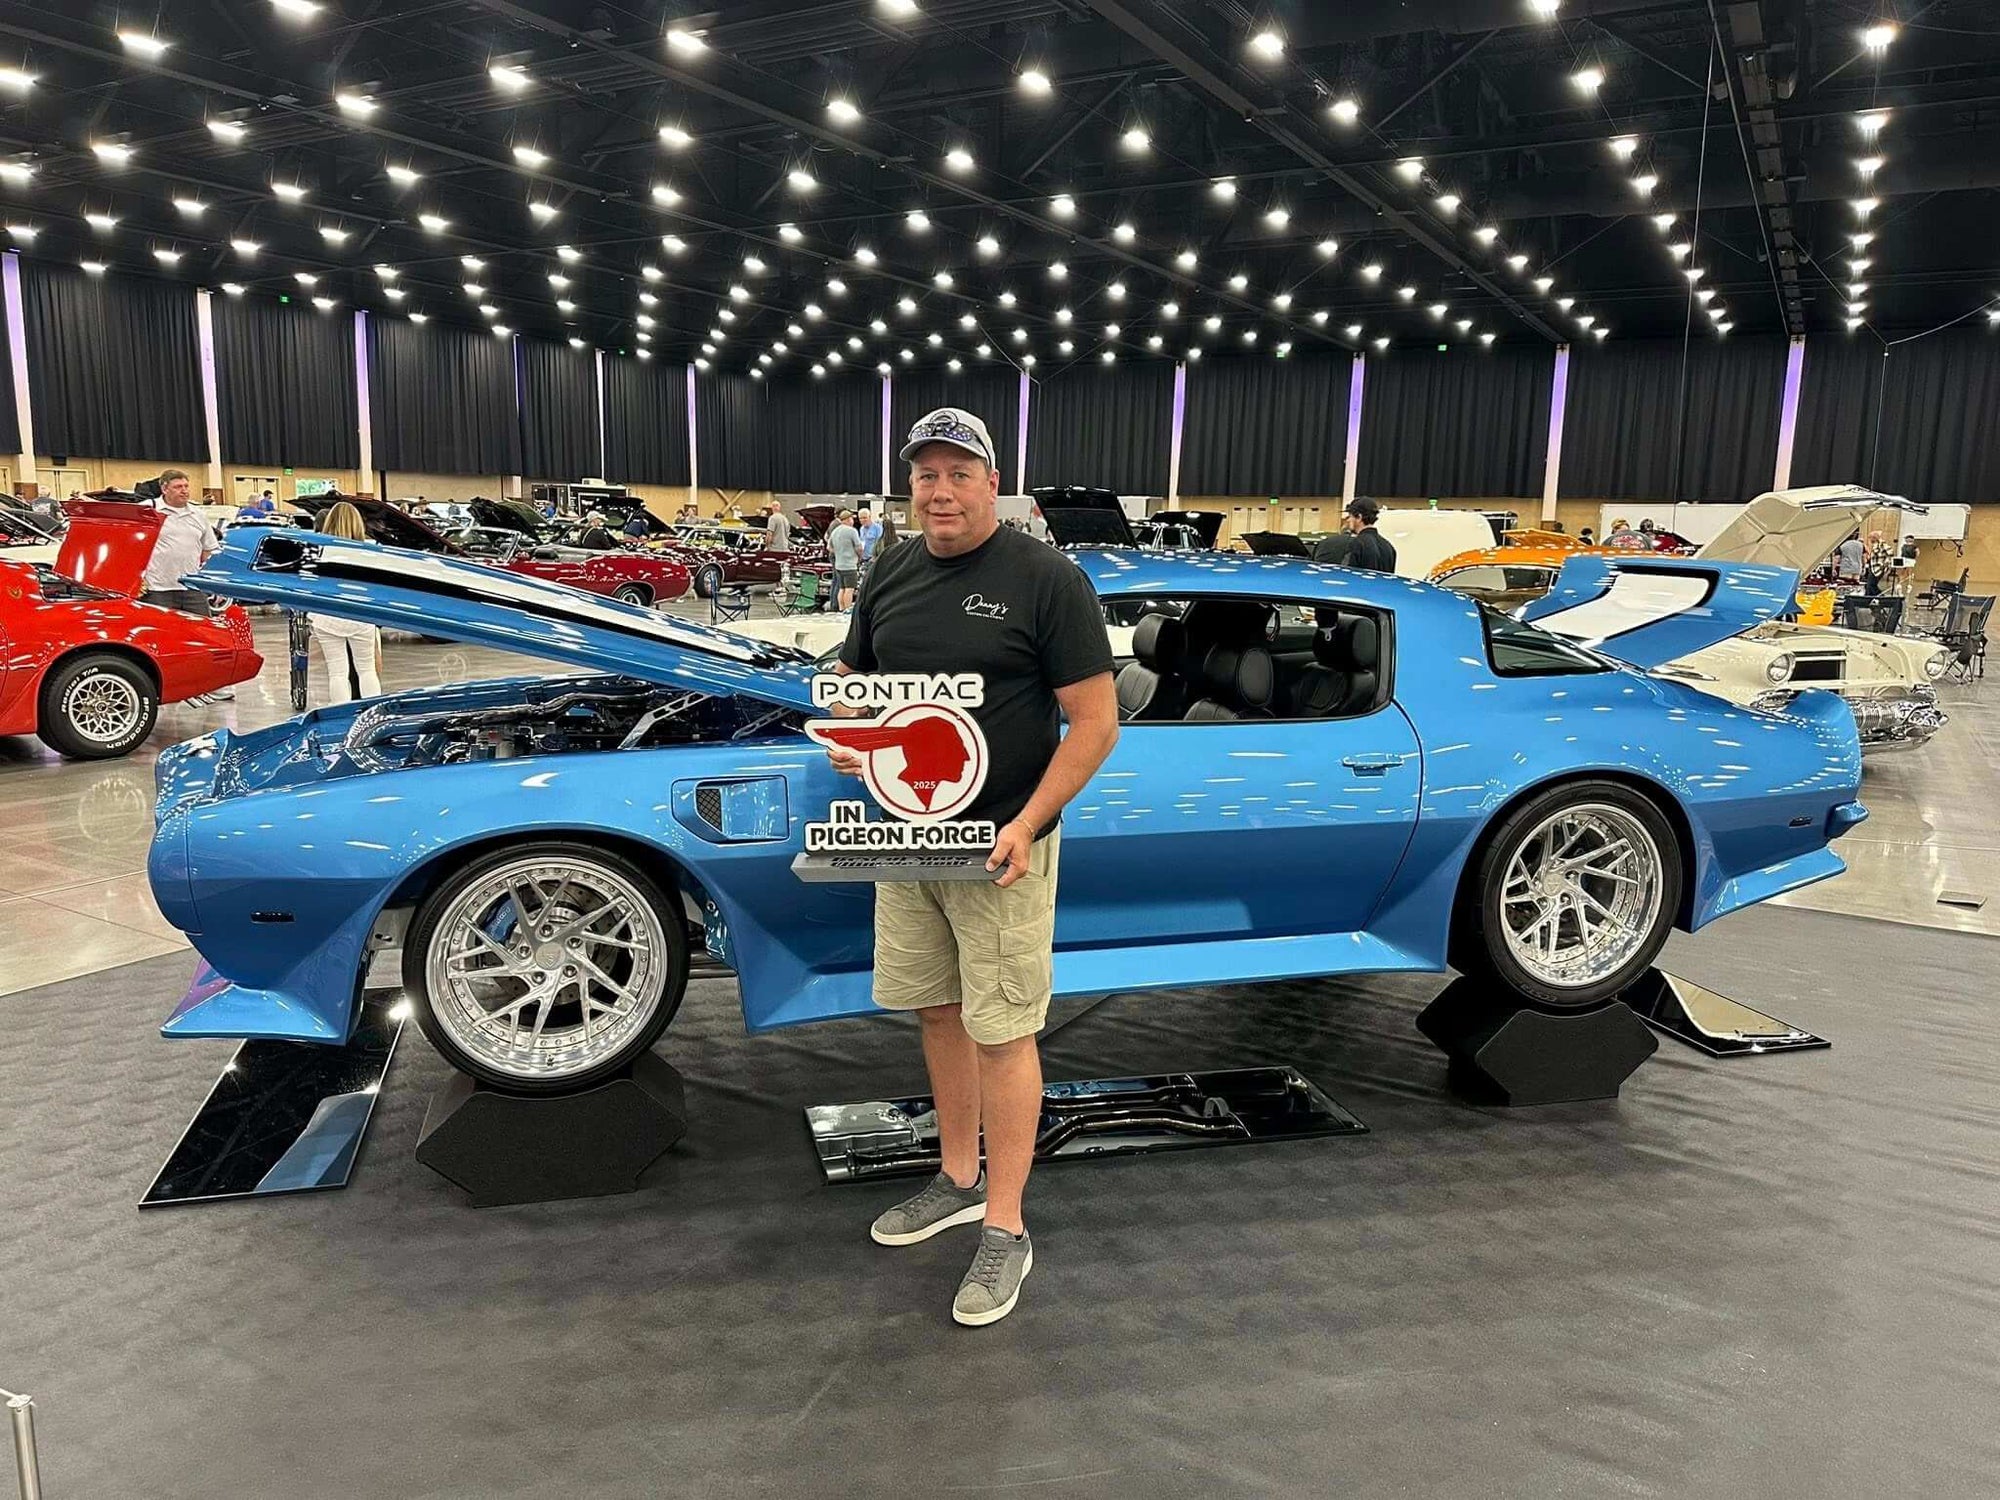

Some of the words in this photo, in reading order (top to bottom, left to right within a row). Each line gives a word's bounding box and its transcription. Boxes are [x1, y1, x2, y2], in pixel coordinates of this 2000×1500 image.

[61, 676, 80, 713] Radial
[81, 667, 99, 677] T/A
[819, 681, 977, 700] PONTIAC
[106, 697, 150, 749] BFGoodrich
[913, 780, 937, 790] 2025
[835, 805, 861, 824] IN
[810, 827, 904, 846] PIGEON
[911, 825, 993, 845] FORGE
